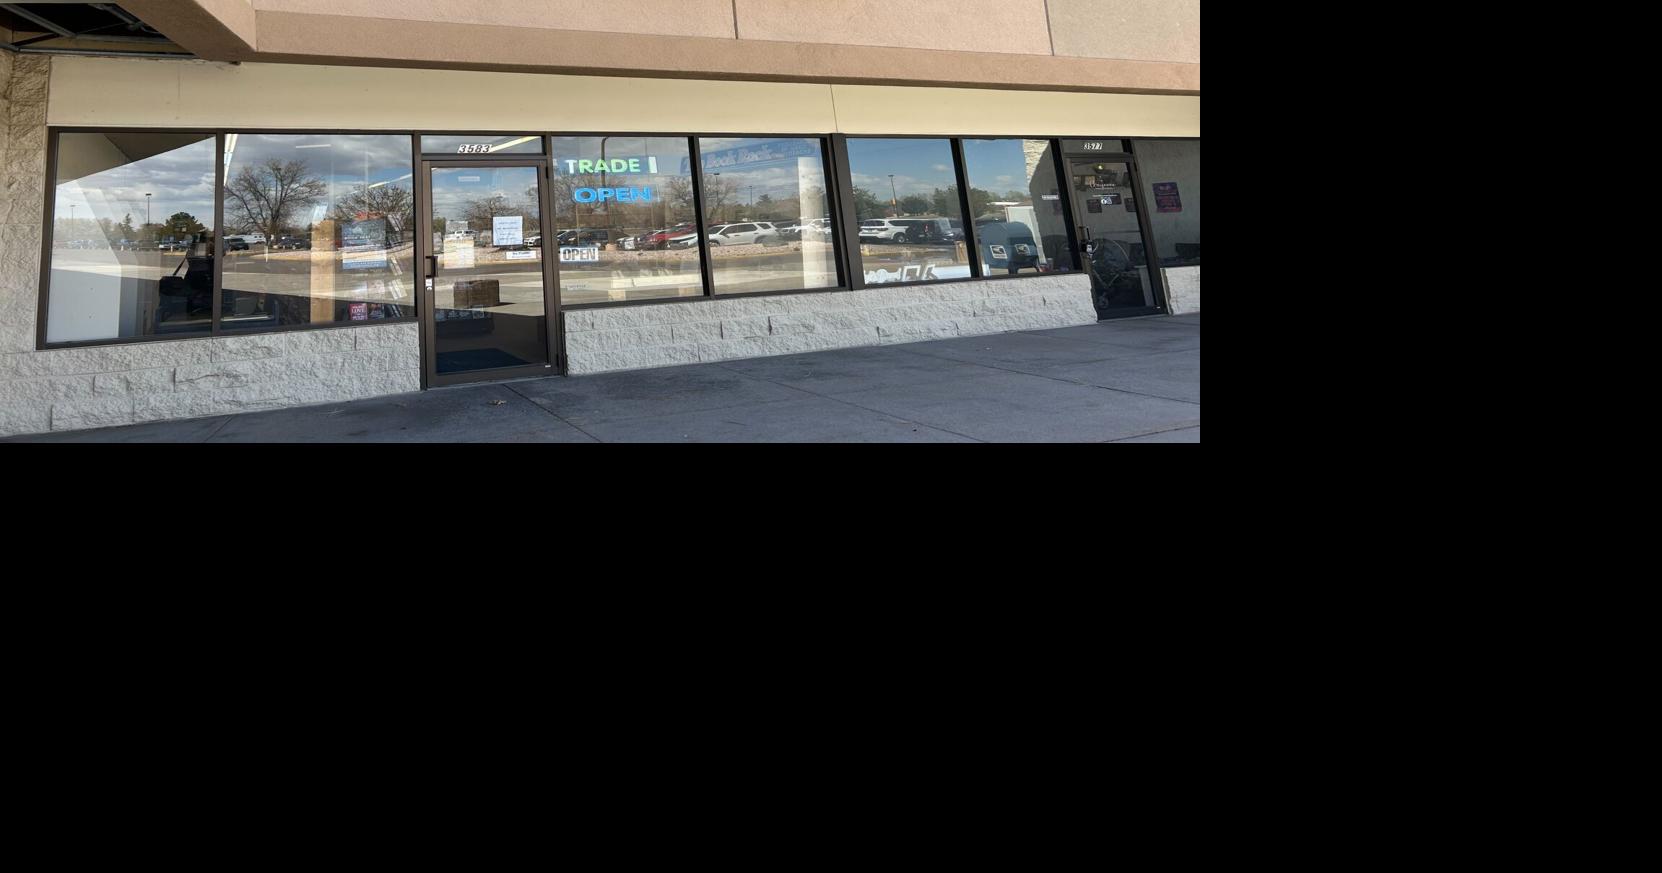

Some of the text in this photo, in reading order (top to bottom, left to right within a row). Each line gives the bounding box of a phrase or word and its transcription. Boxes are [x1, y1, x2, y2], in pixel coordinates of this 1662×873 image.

[458, 144, 490, 153] 3583
[565, 158, 641, 174] TRADE
[574, 187, 652, 203] OPEN
[562, 248, 596, 260] OPEN
